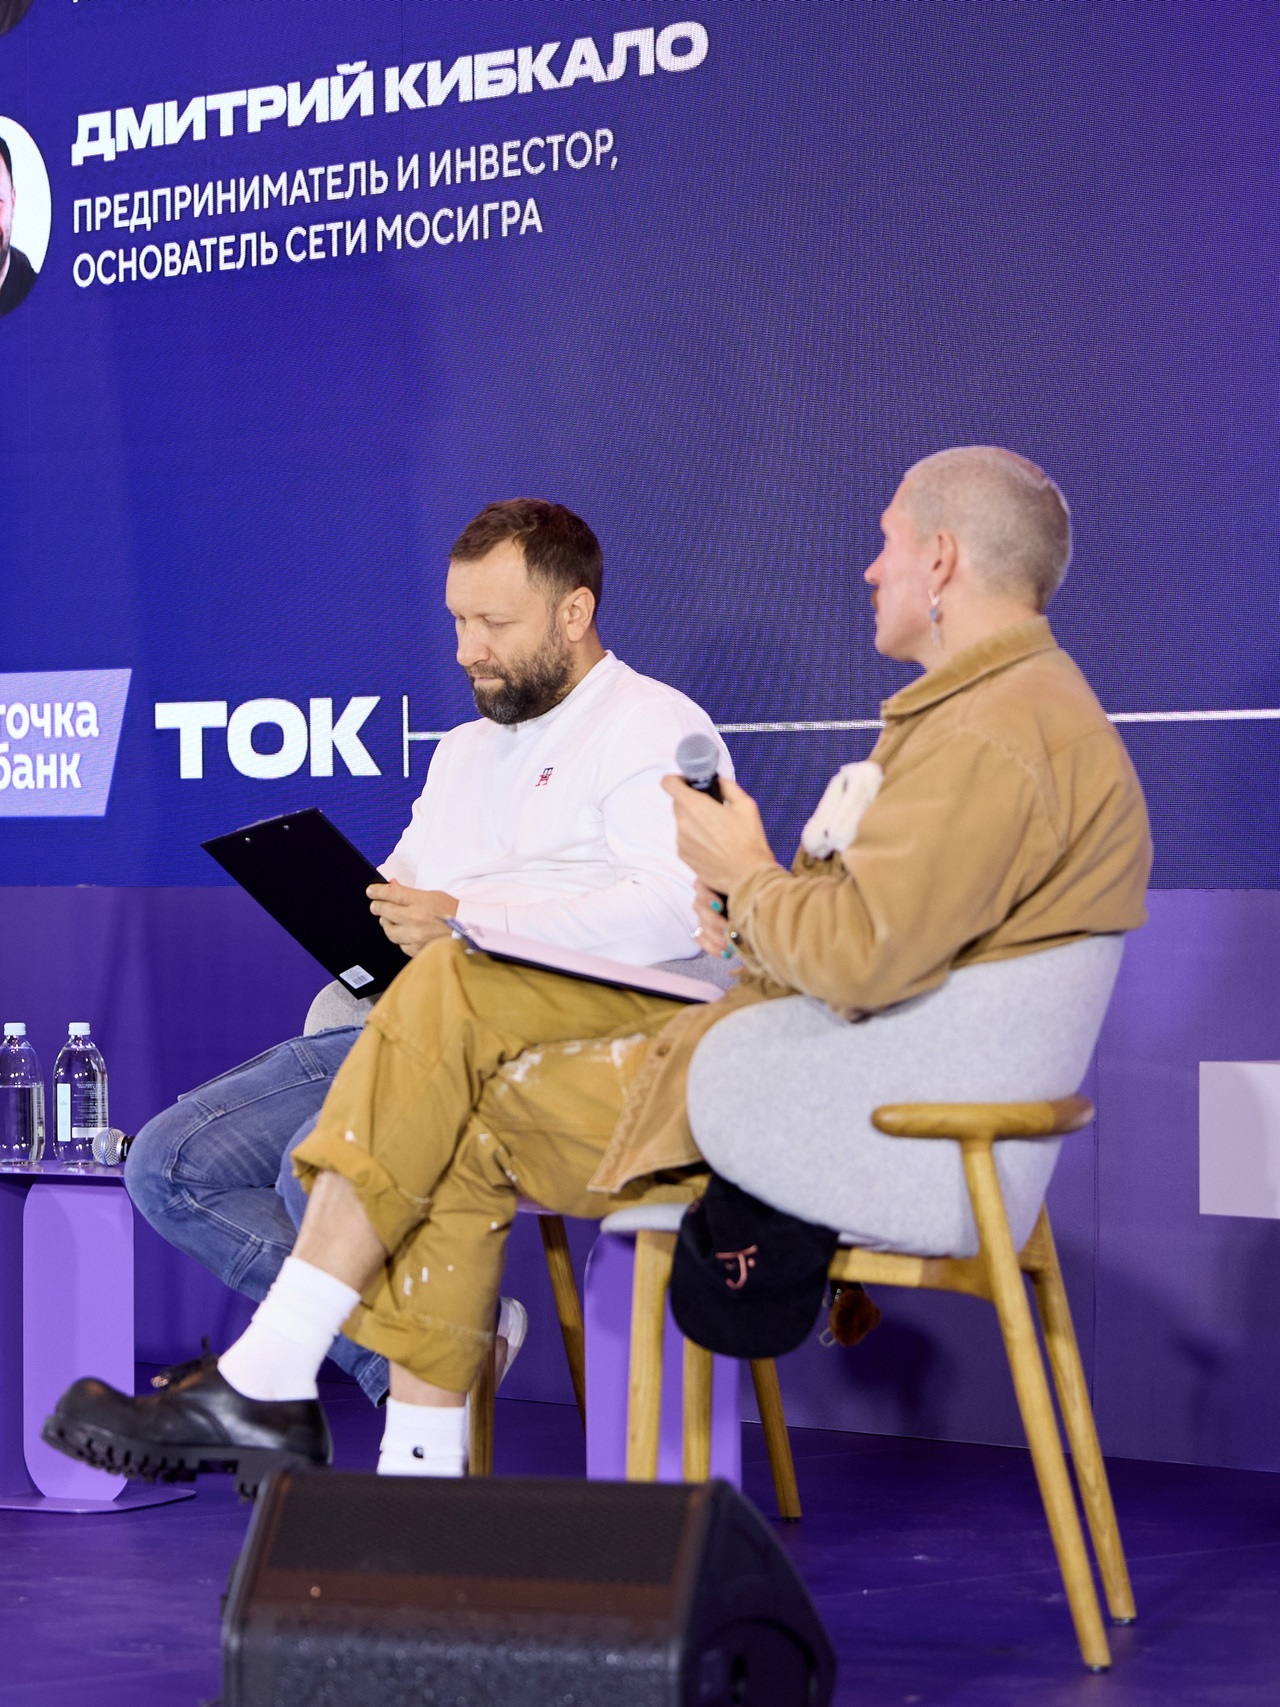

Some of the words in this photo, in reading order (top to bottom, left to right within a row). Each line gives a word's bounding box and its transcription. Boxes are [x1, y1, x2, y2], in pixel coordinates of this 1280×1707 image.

[71, 60, 374, 167] ДМИТРИЙ
[385, 21, 710, 115] КИБКАЛО
[73, 158, 389, 234] ПРЕДПРИНИМАТЕЛЬ
[397, 154, 419, 191] И
[428, 128, 618, 188] ИНВЕСТОР,
[73, 232, 279, 288] ОСНОВАТЕЛЬ
[285, 218, 368, 263] СЕТИ
[375, 198, 543, 250] МОСИГРА
[154, 696, 382, 779] ТОК
